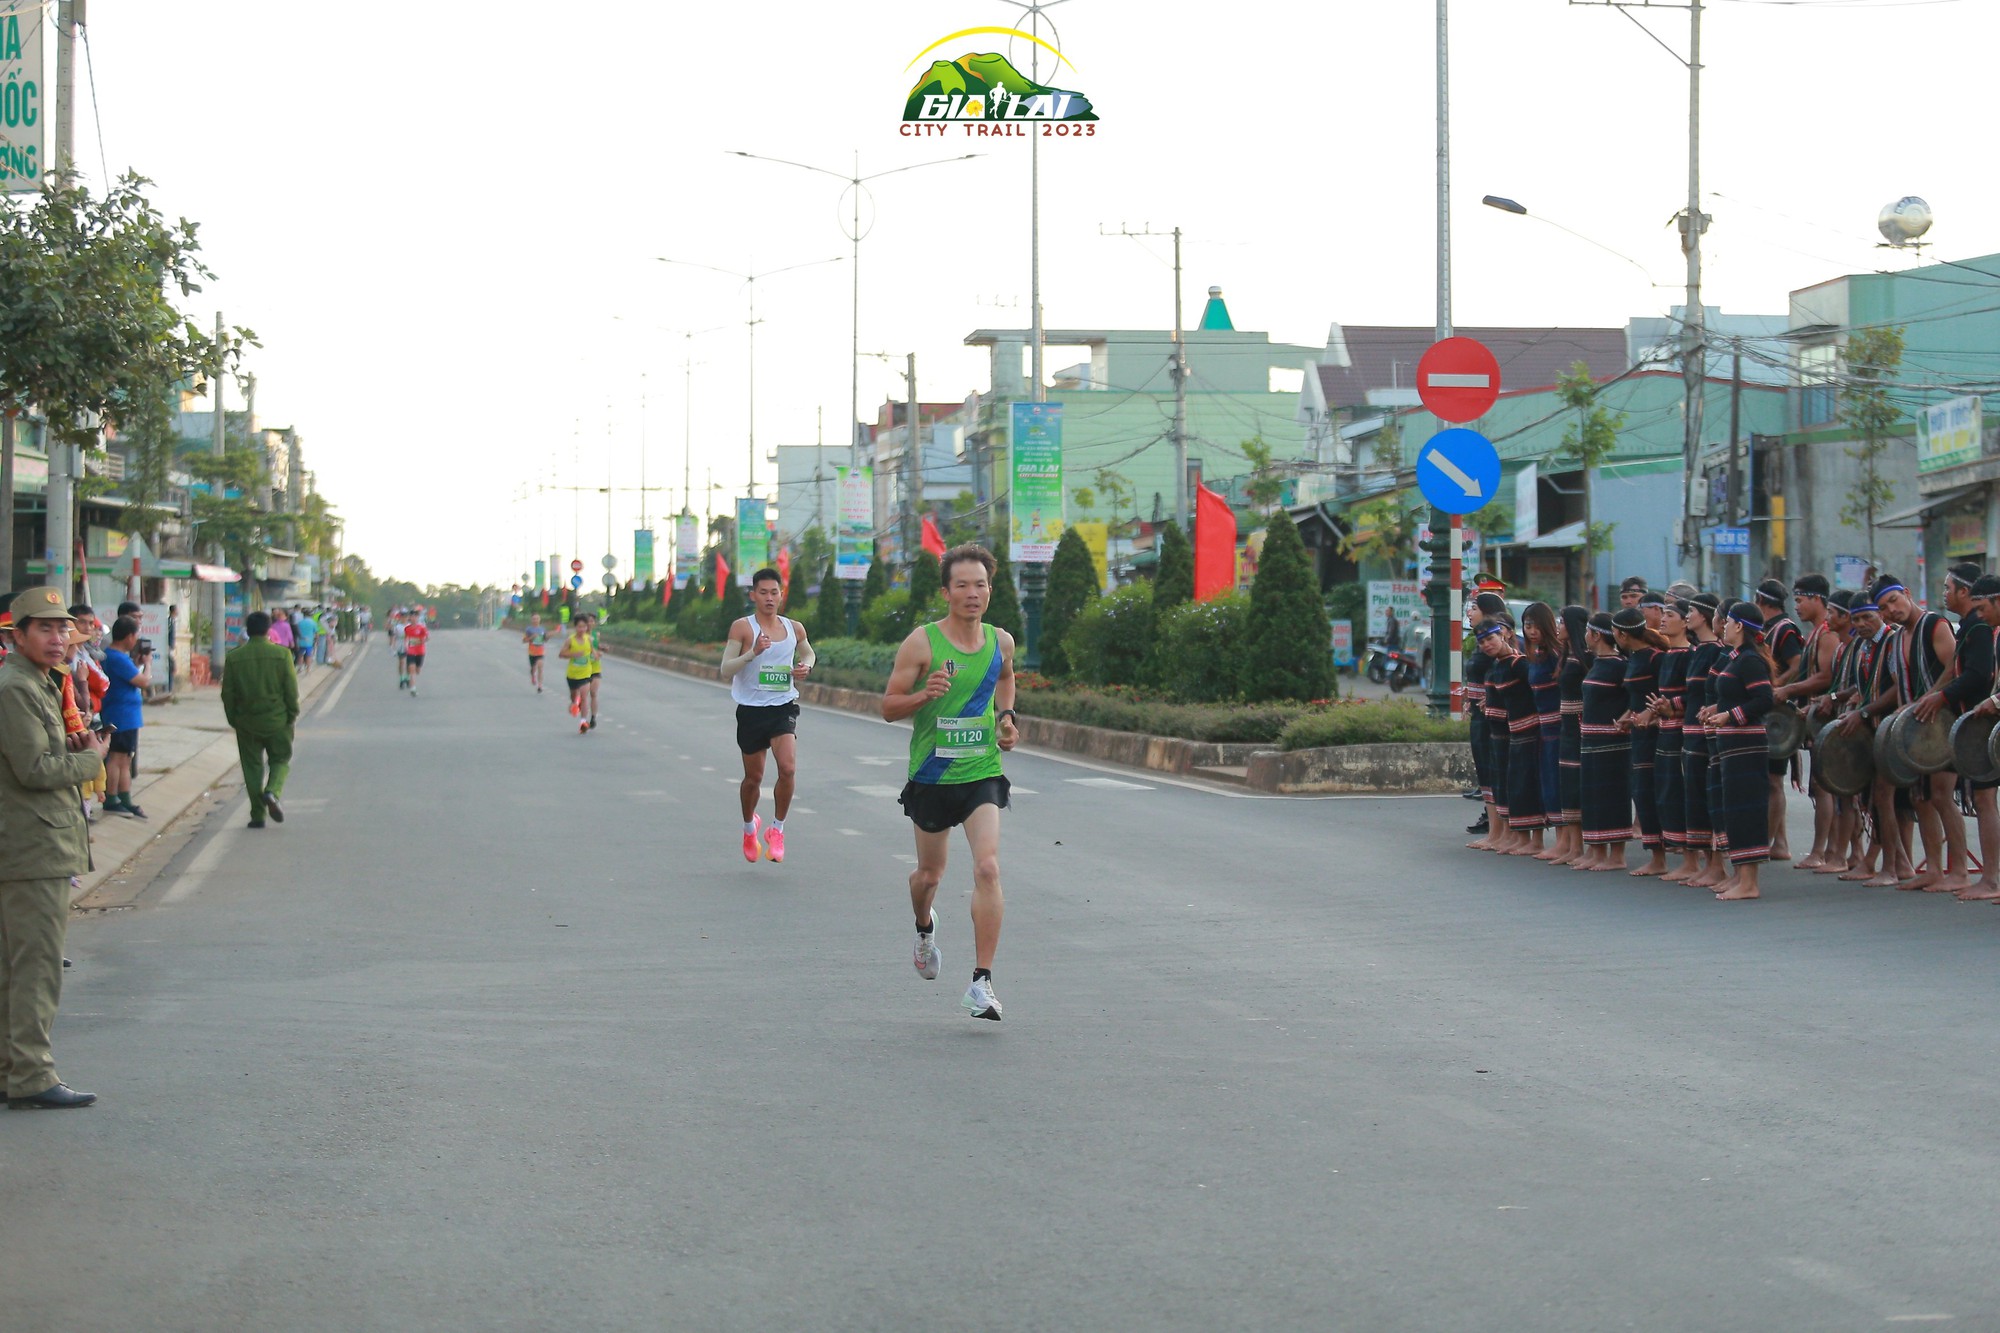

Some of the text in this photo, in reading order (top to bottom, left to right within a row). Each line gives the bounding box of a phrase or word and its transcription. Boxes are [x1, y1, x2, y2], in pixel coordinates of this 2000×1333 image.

[0, 5, 22, 60] À
[0, 68, 37, 128] ỐC
[1017, 464, 1059, 473] GIA LAI
[765, 673, 788, 682] 10763
[945, 730, 983, 743] 11120
